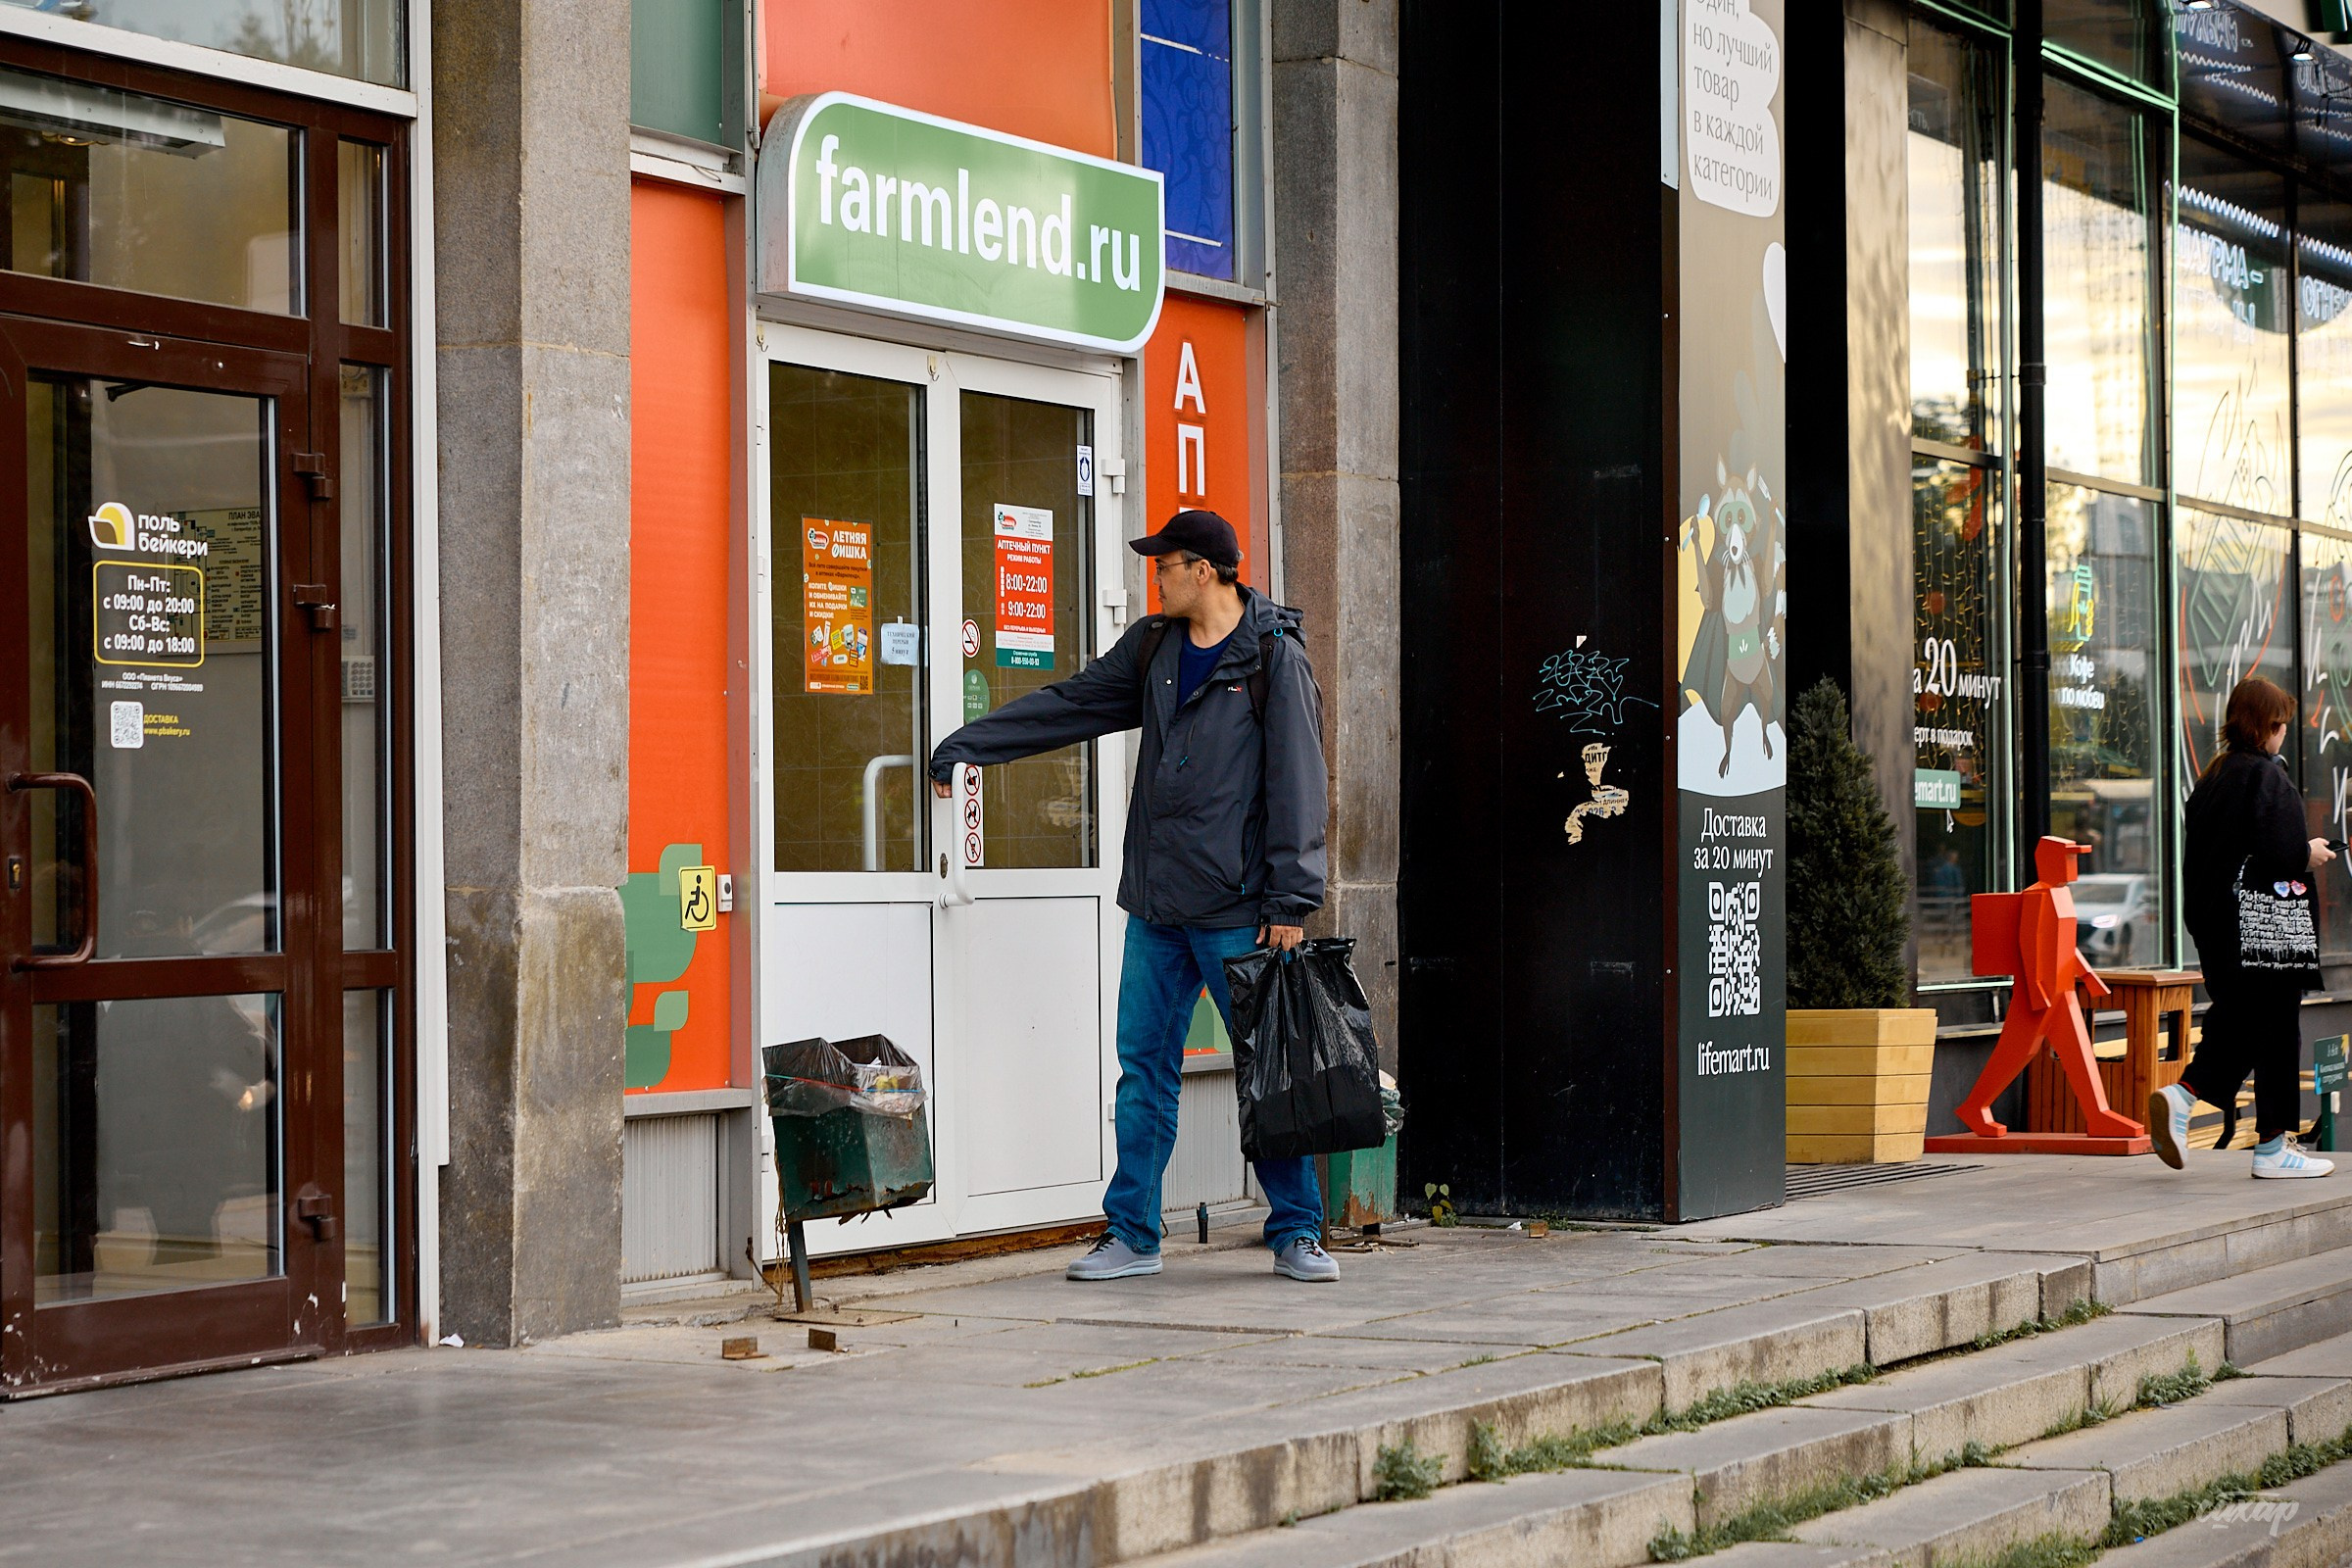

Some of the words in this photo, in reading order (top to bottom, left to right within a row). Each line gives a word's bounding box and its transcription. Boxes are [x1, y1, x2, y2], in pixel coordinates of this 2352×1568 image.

[1693, 23, 1713, 50] но
[1717, 32, 1773, 74] лучший
[1693, 66, 1740, 111] товар
[1693, 110, 1702, 133] в
[1706, 114, 1764, 155] каждой
[1693, 154, 1773, 203] категории
[815, 133, 1142, 293] farmlend.ru
[1174, 341, 1206, 515] АП
[138, 532, 209, 560] бейкери
[833, 529, 867, 545] ЛЕТНЯЯ
[997, 539, 1031, 552] АПТЕЧНЫЙ
[1031, 543, 1052, 555] ПУНКТ
[127, 574, 172, 593] Пн-Пт:
[1005, 572, 1048, 594] 8:00-22:00
[103, 596, 111, 610] с
[114, 593, 144, 612] 09:00
[146, 599, 163, 614] до
[165, 597, 195, 614] 20:00
[1007, 600, 1047, 619] 9:00-22:00
[128, 613, 171, 633] Сб-Вс:
[104, 636, 112, 649] с
[114, 633, 145, 652] 09:00
[147, 638, 164, 654] до
[166, 636, 195, 654] 18:00
[1924, 636, 1957, 698] 20
[1958, 672, 2001, 710] минут
[143, 714, 179, 724] ДОСТАВКА
[1931, 729, 1936, 743] в
[1936, 729, 1974, 751] подарок
[1700, 808, 1767, 843] Доставка
[1693, 847, 1709, 870] за
[1712, 845, 1730, 870] 20
[1733, 848, 1774, 879] минут
[1697, 1041, 1771, 1076] lifemart.ru
